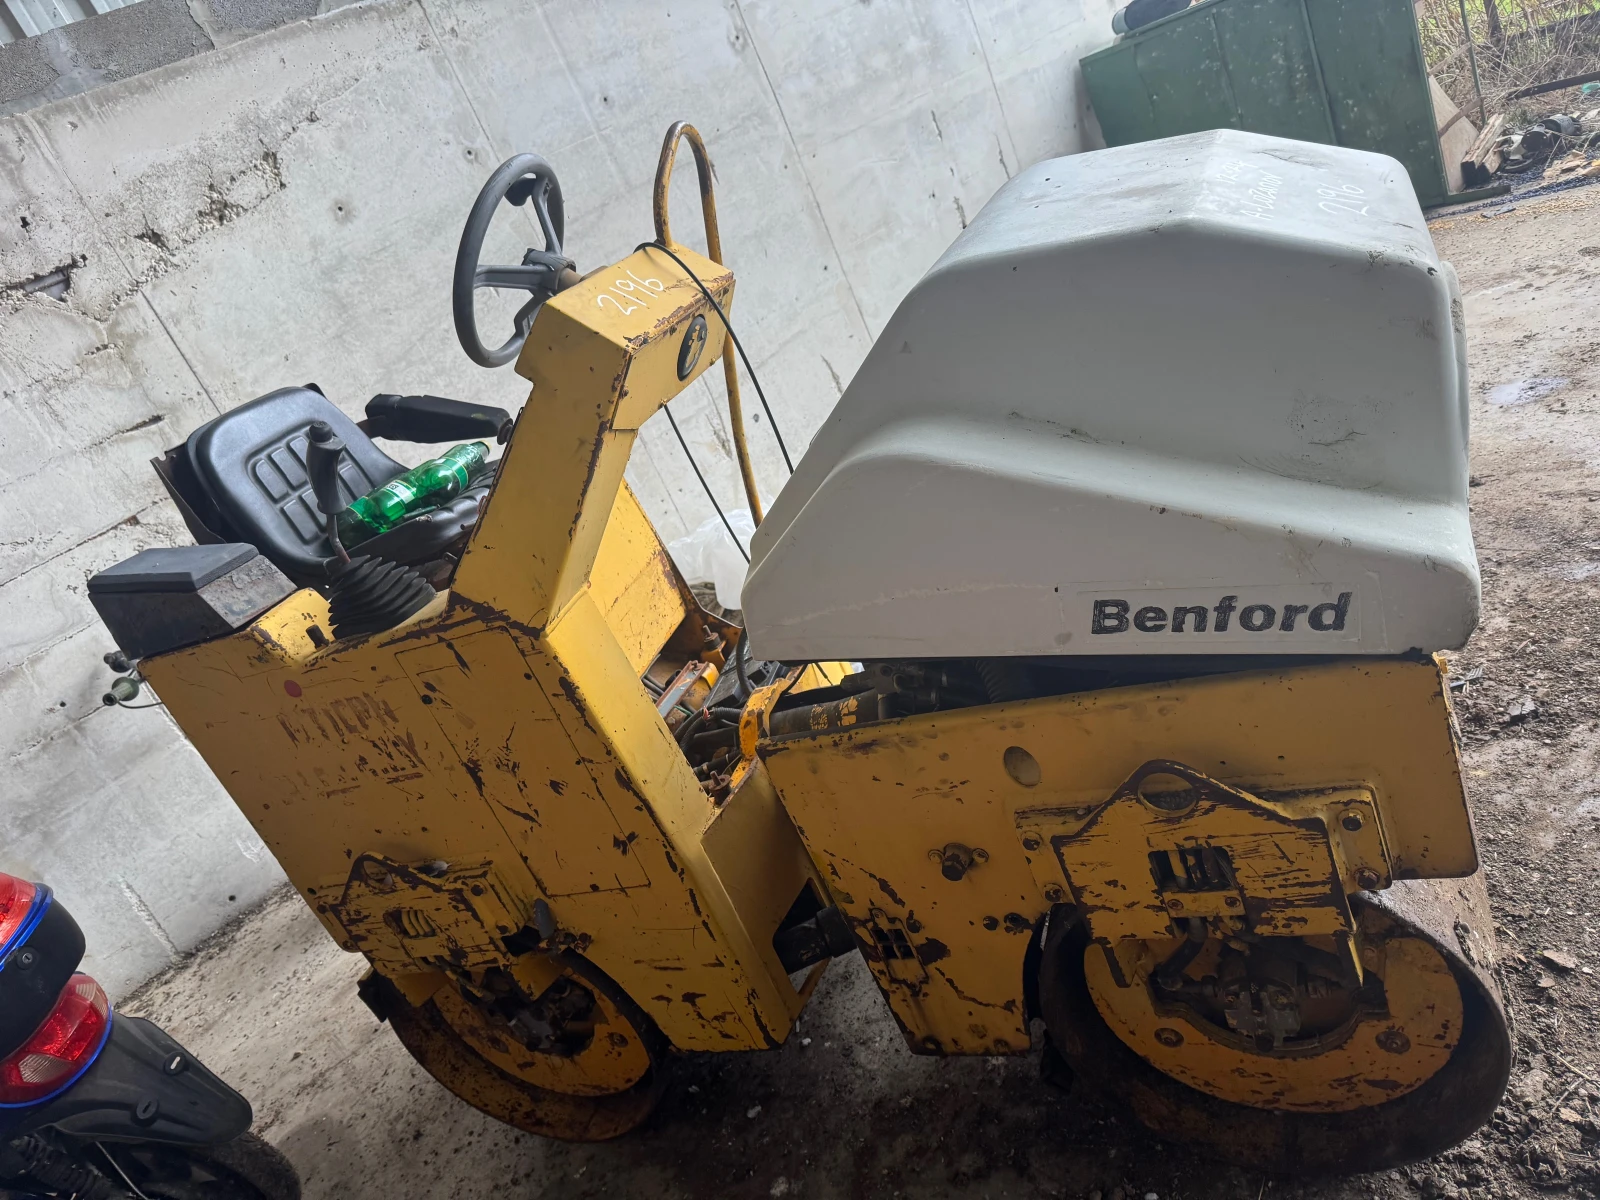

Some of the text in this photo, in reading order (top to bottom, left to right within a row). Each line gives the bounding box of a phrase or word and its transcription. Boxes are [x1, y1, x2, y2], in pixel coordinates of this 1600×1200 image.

[1316, 183, 1370, 217] 2196
[596, 269, 664, 316] 2196
[1091, 591, 1353, 635] Benford
